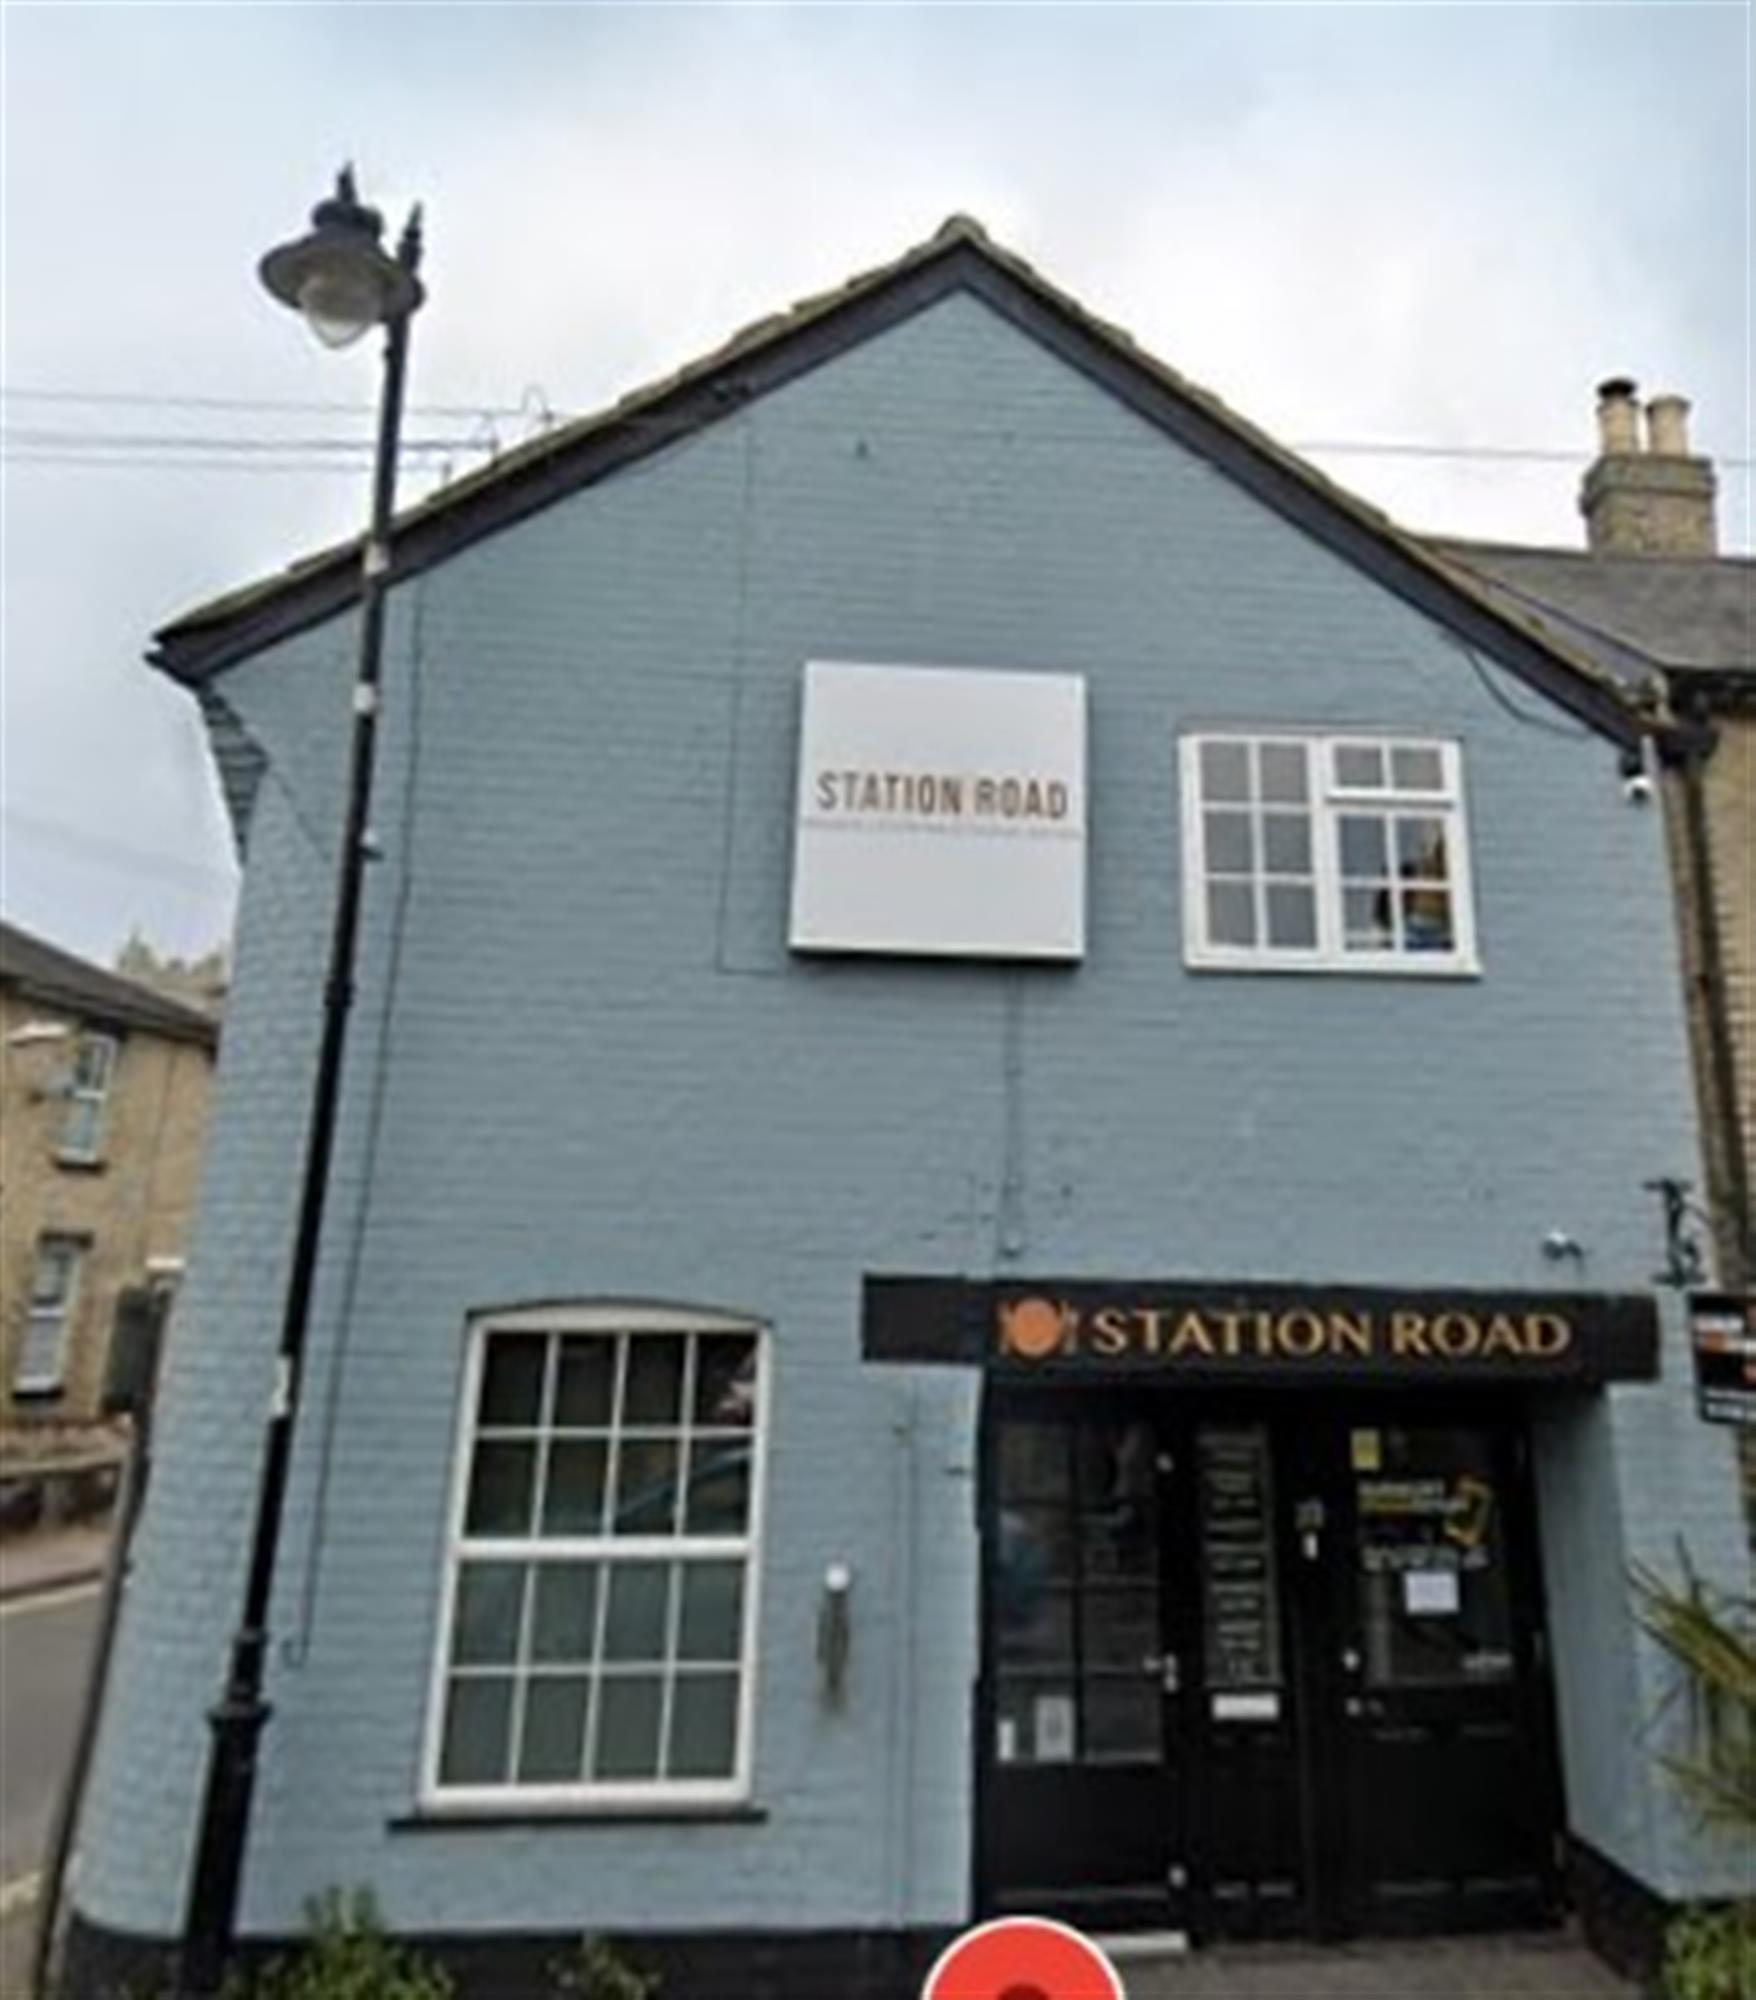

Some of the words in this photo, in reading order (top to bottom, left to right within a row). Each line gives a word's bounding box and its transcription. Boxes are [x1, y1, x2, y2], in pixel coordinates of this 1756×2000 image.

[817, 771, 963, 815] STATION
[975, 777, 1068, 819] ROAD
[1094, 1308, 1372, 1355] STATION
[1391, 1312, 1570, 1357] ROAD
